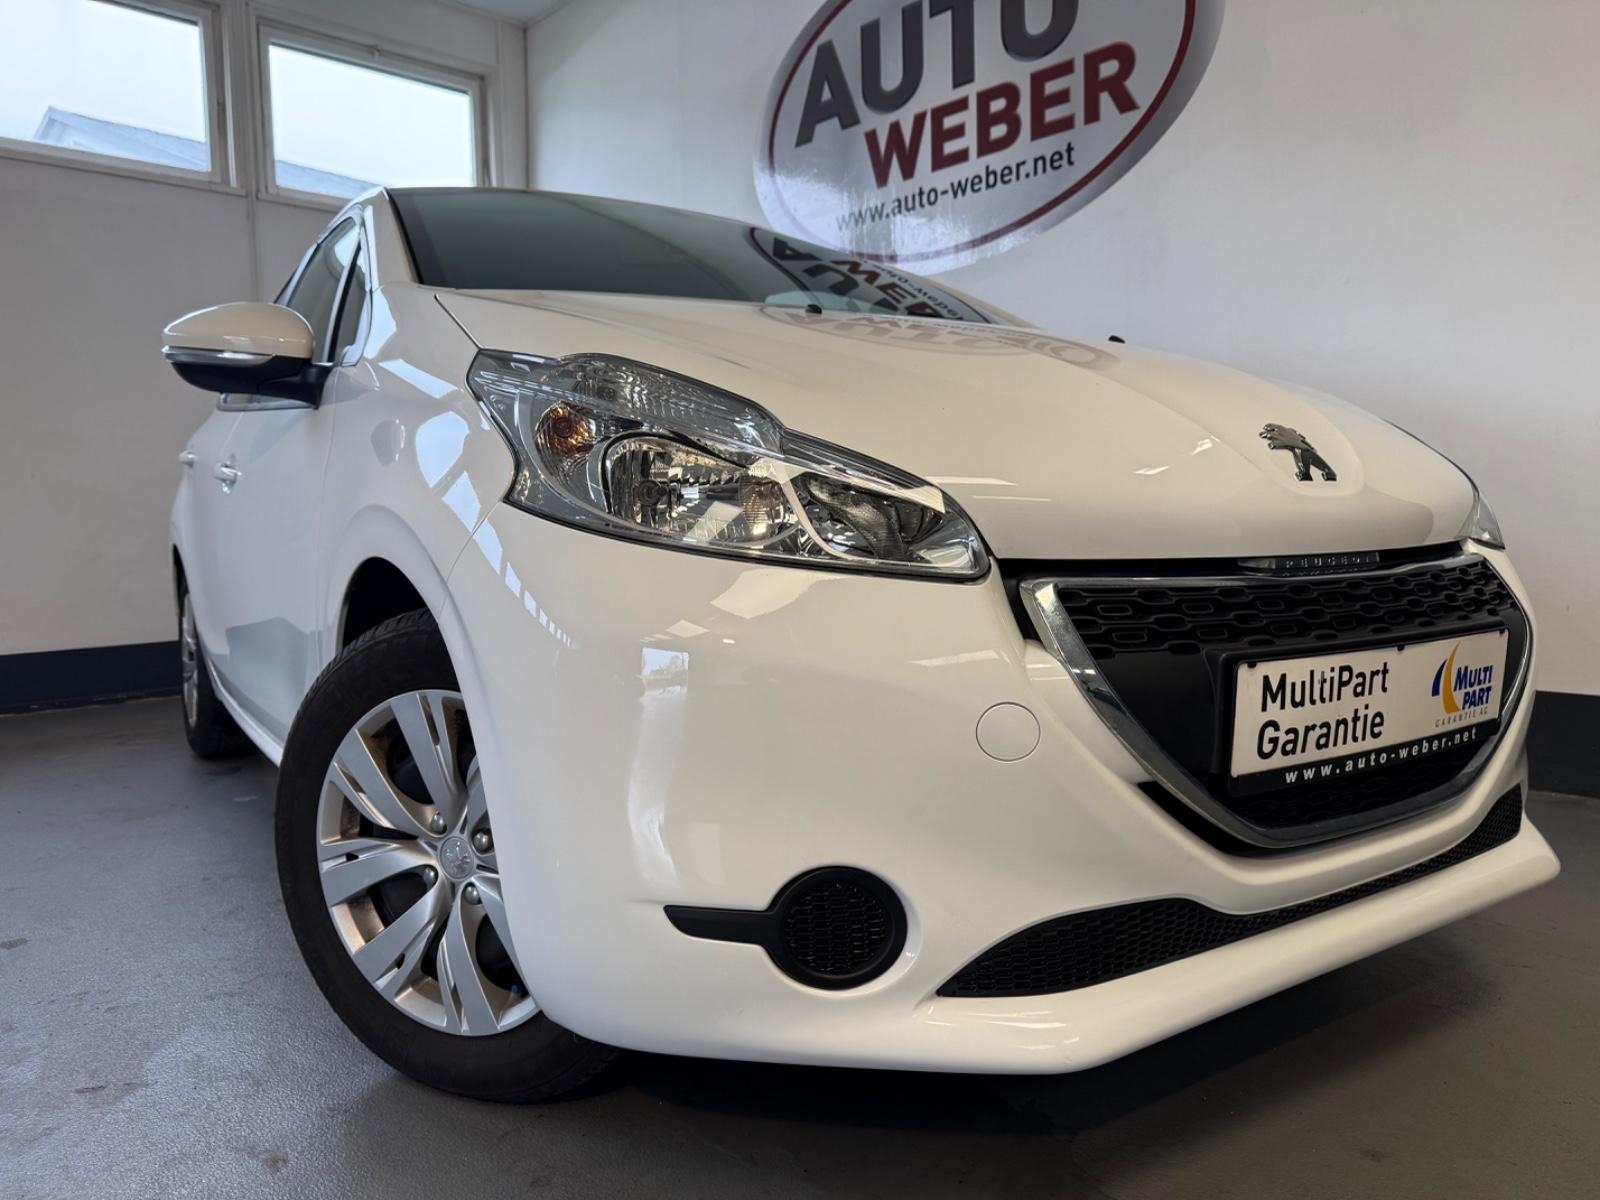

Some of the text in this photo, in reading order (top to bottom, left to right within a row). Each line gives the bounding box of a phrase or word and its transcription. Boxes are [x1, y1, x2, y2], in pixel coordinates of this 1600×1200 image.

[864, 41, 1141, 189] WEBER
[836, 141, 1075, 232] www.auto-weber.net
[1261, 662, 1389, 712] MultiPart
[1461, 686, 1492, 710] PART
[1257, 704, 1385, 760] Garantie
[1285, 728, 1477, 784] www.auto-weber.net
